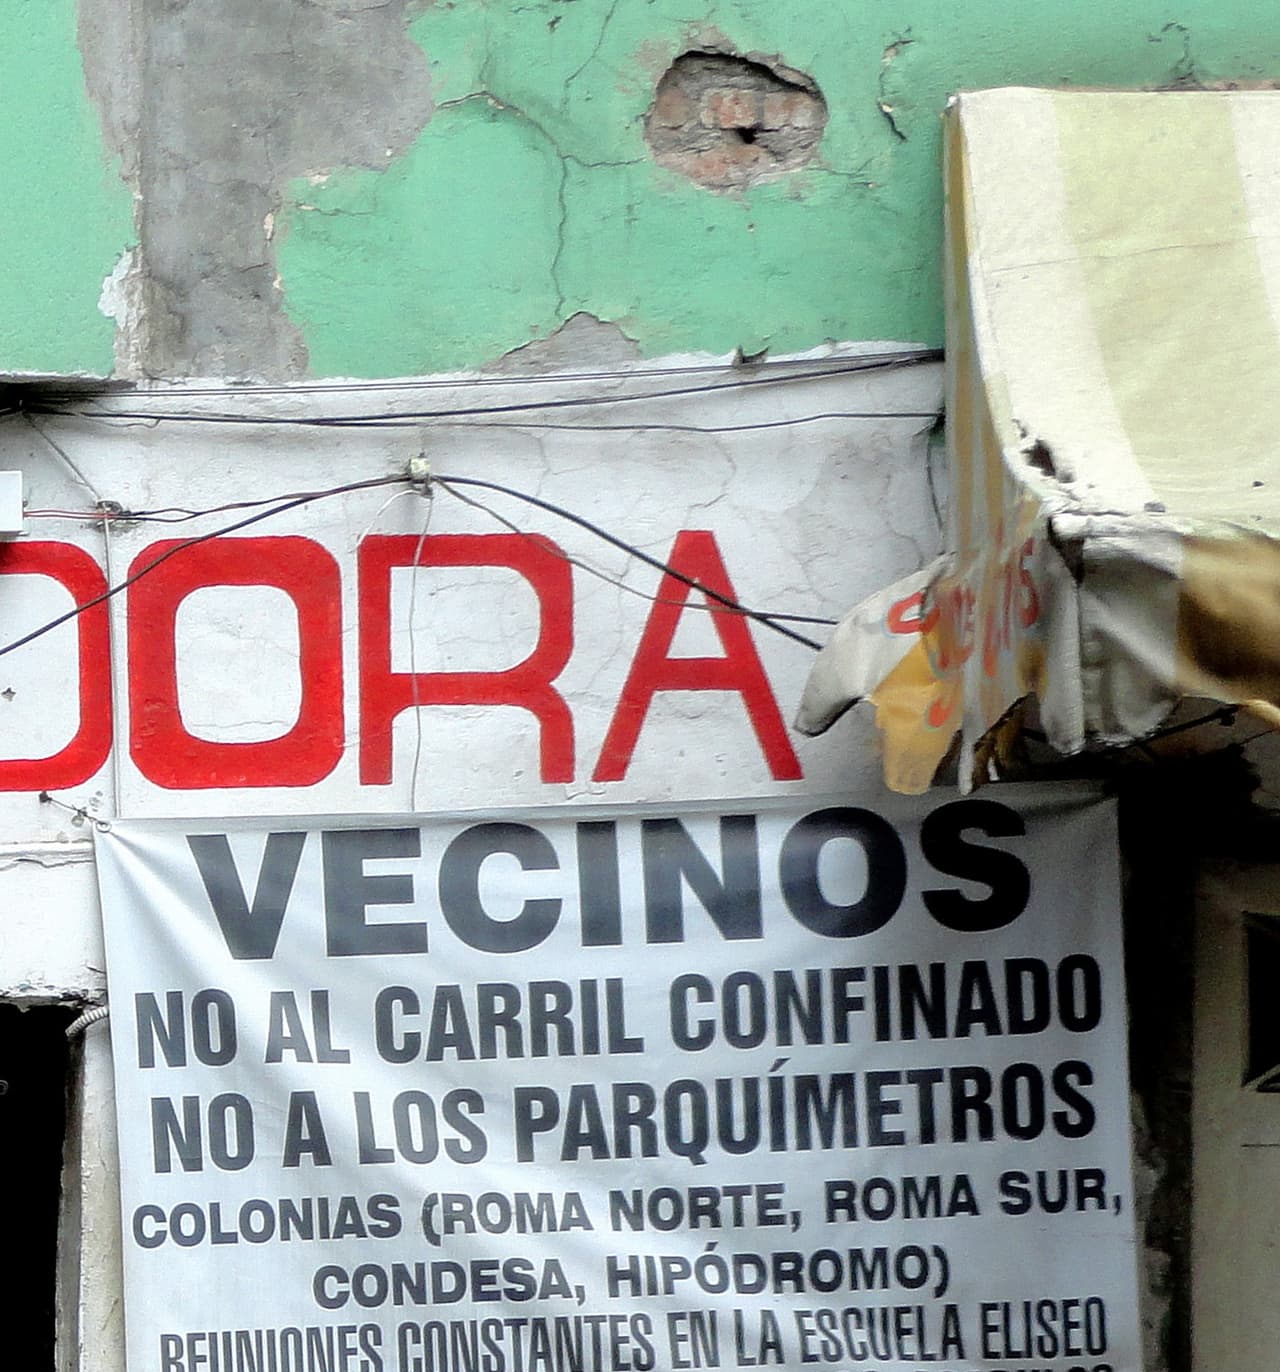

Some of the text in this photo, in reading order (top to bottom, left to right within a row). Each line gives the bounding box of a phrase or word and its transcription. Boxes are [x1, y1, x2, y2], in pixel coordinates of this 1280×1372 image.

[185, 800, 1031, 960] VECINOS
[134, 954, 1101, 1068] NO AL CARRIL CONFINADO
[151, 1057, 1096, 1173] NO A LOS PARQUÍMETROS
[133, 1168, 1122, 1248] COLONIAS (ROMA NORTE, ROMA SUR,
[313, 1241, 951, 1309] CONDESA, HIPÓDROMO)
[667, 1309, 720, 1369] EN
[734, 1306, 785, 1366] LA
[794, 1304, 965, 1364] ESCUELA
[980, 1297, 1107, 1360] ELISEO
